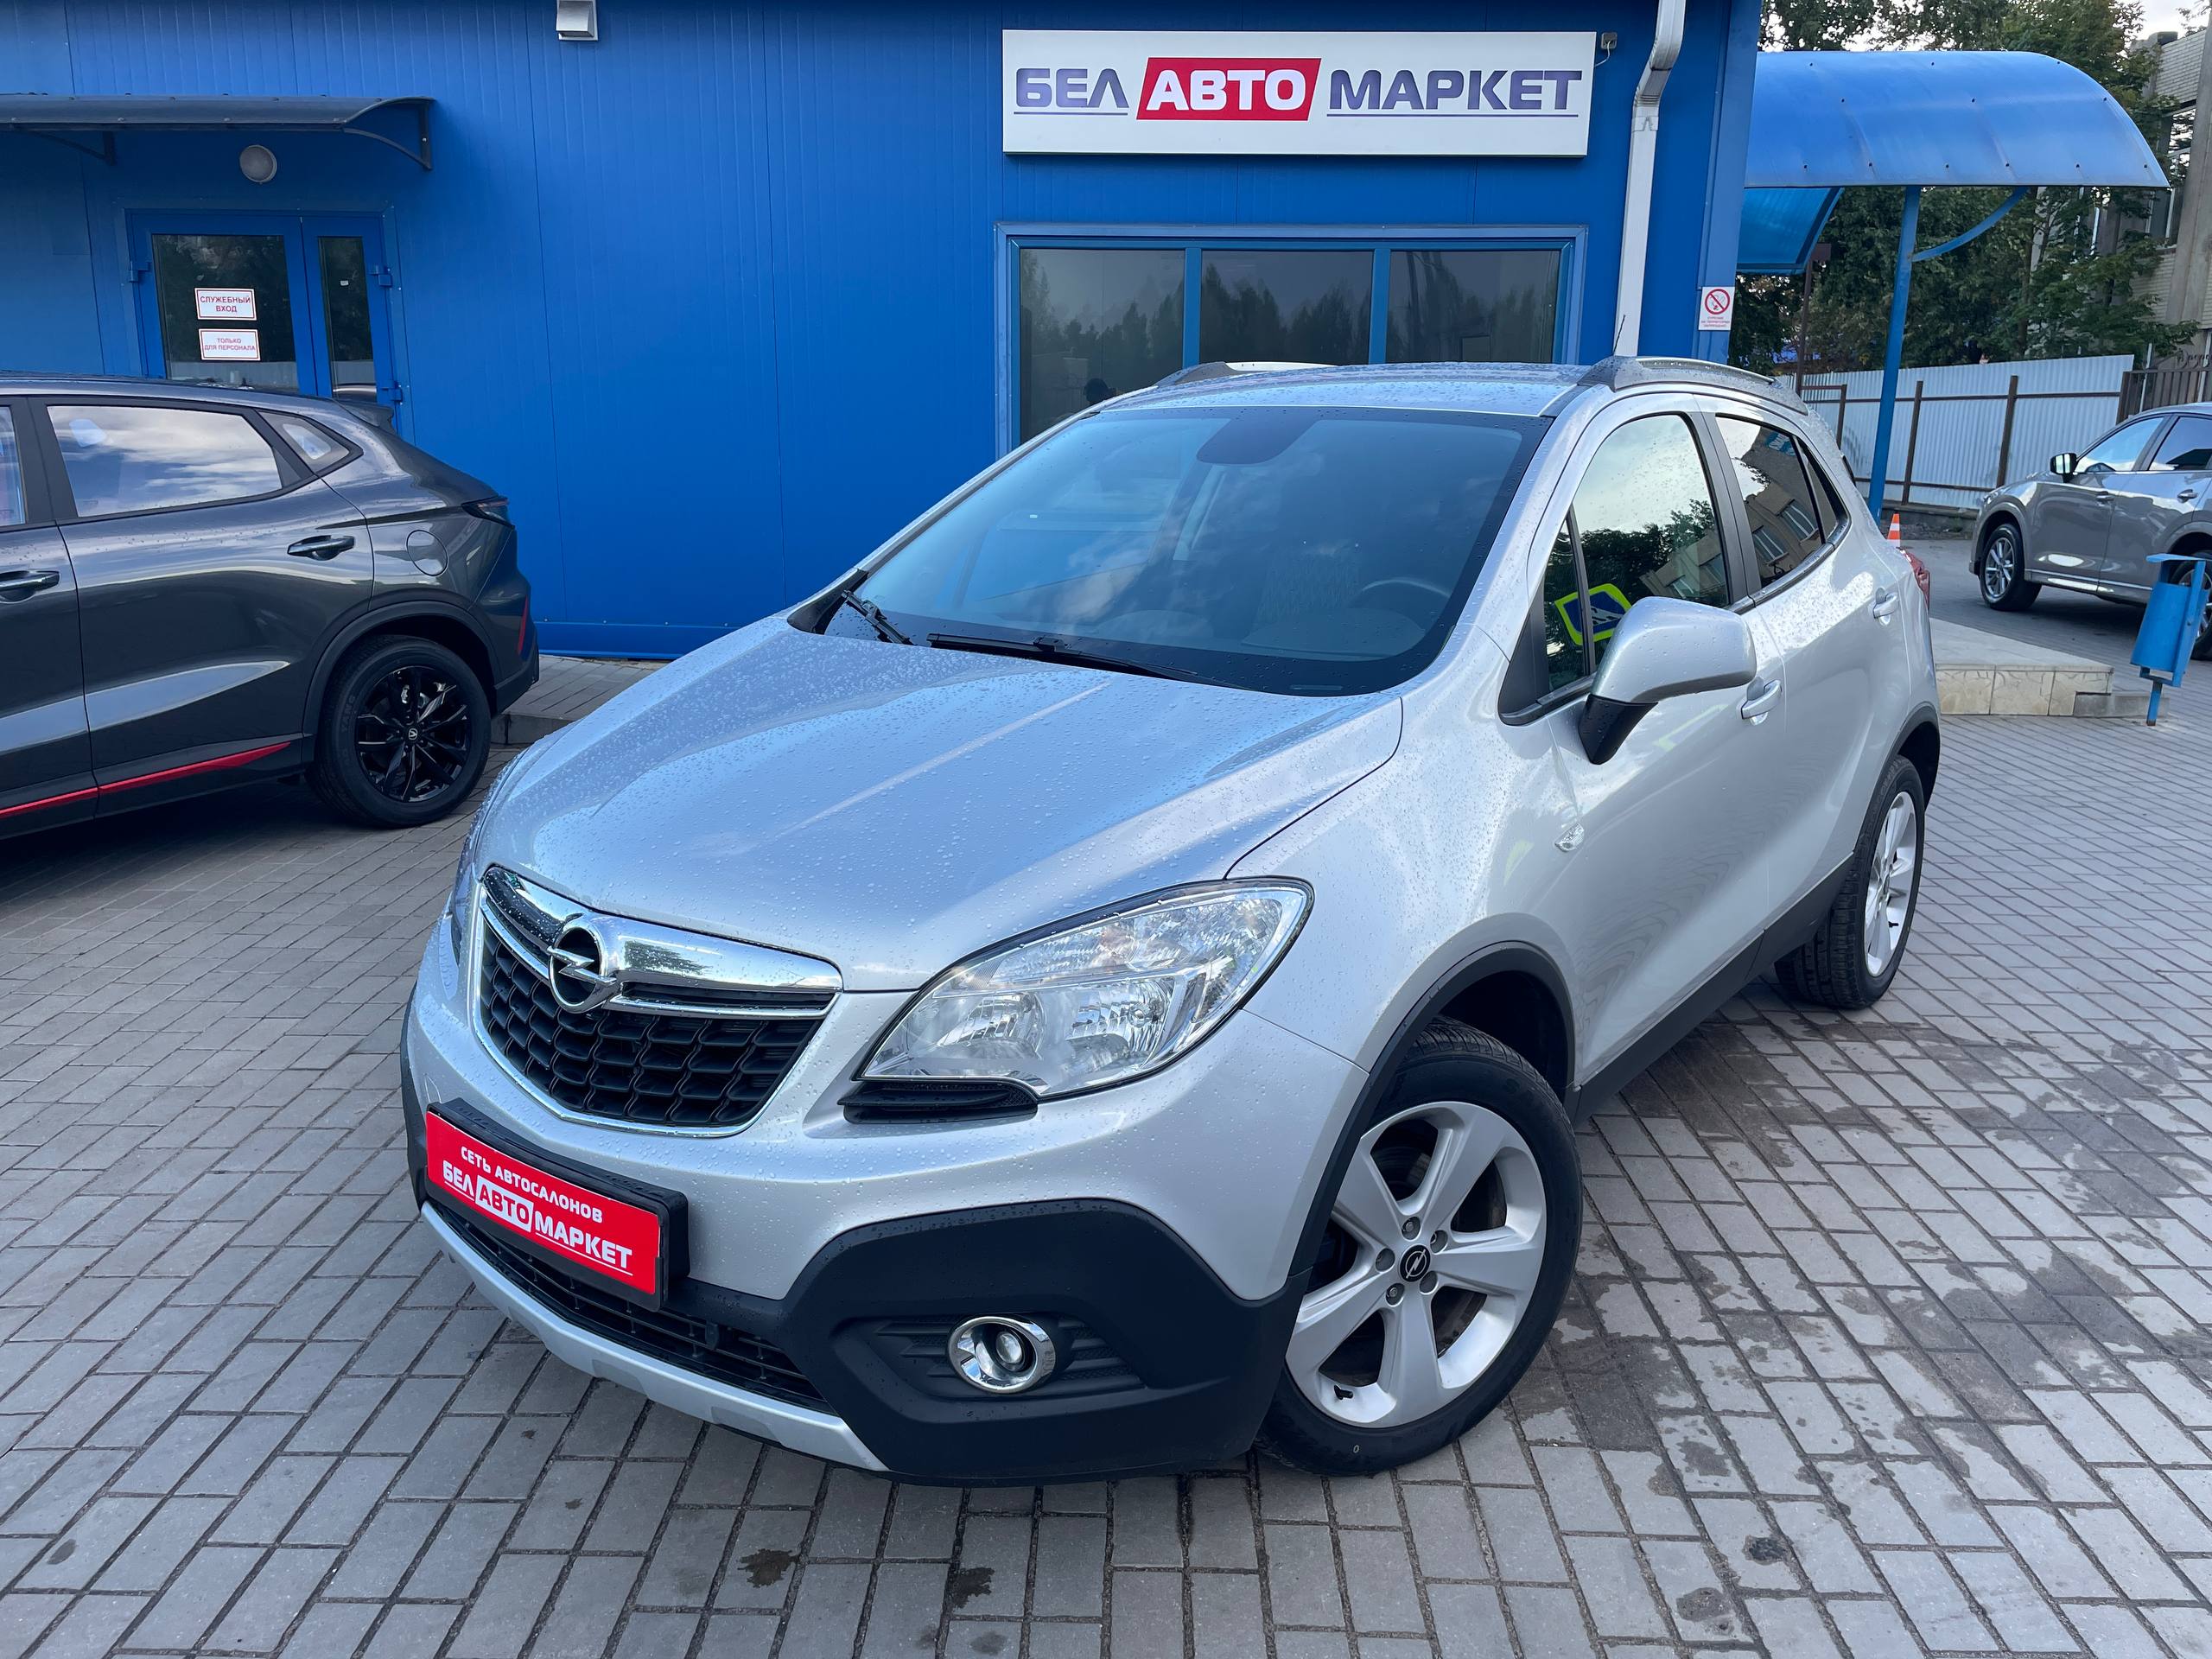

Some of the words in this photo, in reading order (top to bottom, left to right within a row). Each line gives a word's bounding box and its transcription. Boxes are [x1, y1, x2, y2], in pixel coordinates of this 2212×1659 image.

[1015, 67, 1129, 109] БЕЛ
[1146, 69, 1306, 111] АВТО
[1329, 69, 1583, 111] МАРКЕТ
[442, 1160, 474, 1197] БЕЛ
[479, 1181, 530, 1223] АВТО
[534, 1210, 632, 1269] МАРКЕТ
[460, 1145, 493, 1174] СЕТЬ
[494, 1165, 603, 1224] АВТОСАЛОНОВ
